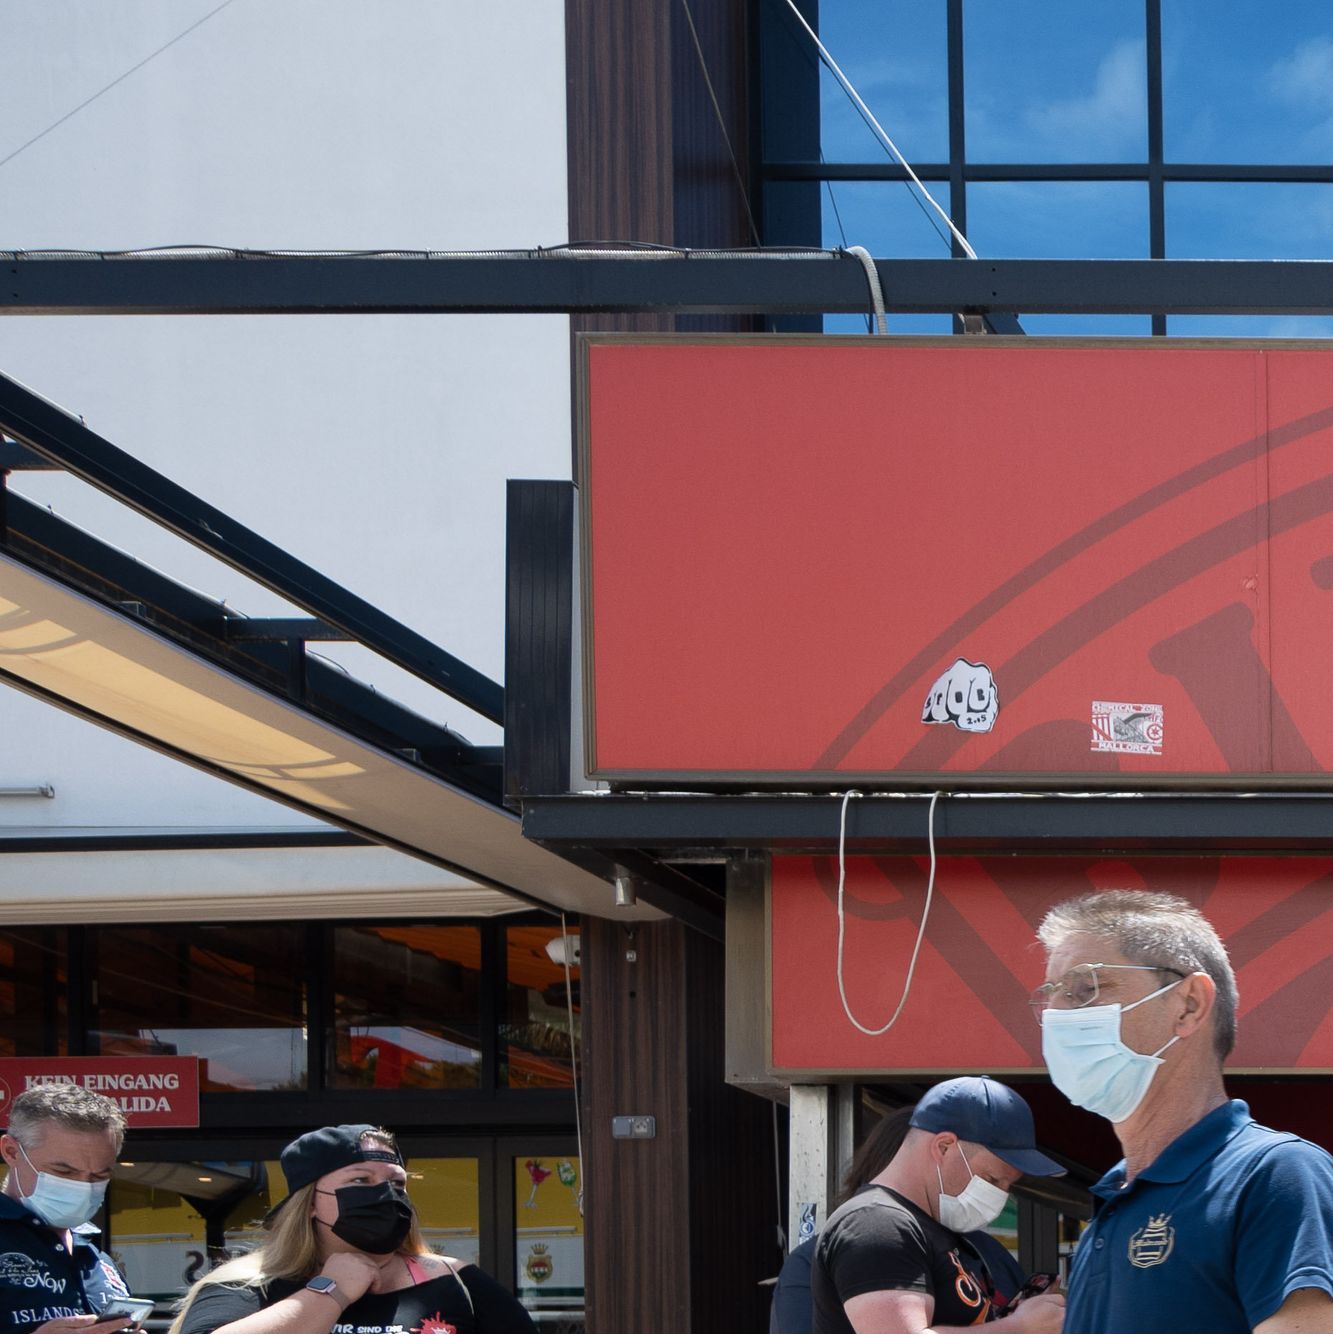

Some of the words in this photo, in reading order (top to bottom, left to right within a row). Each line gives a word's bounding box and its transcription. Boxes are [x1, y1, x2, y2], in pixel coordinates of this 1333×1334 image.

[1099, 742, 1155, 753] MALLORCA
[83, 1073, 179, 1090] EINGANG
[110, 1096, 172, 1113] ALIDA
[357, 1325, 382, 1334] SIND
